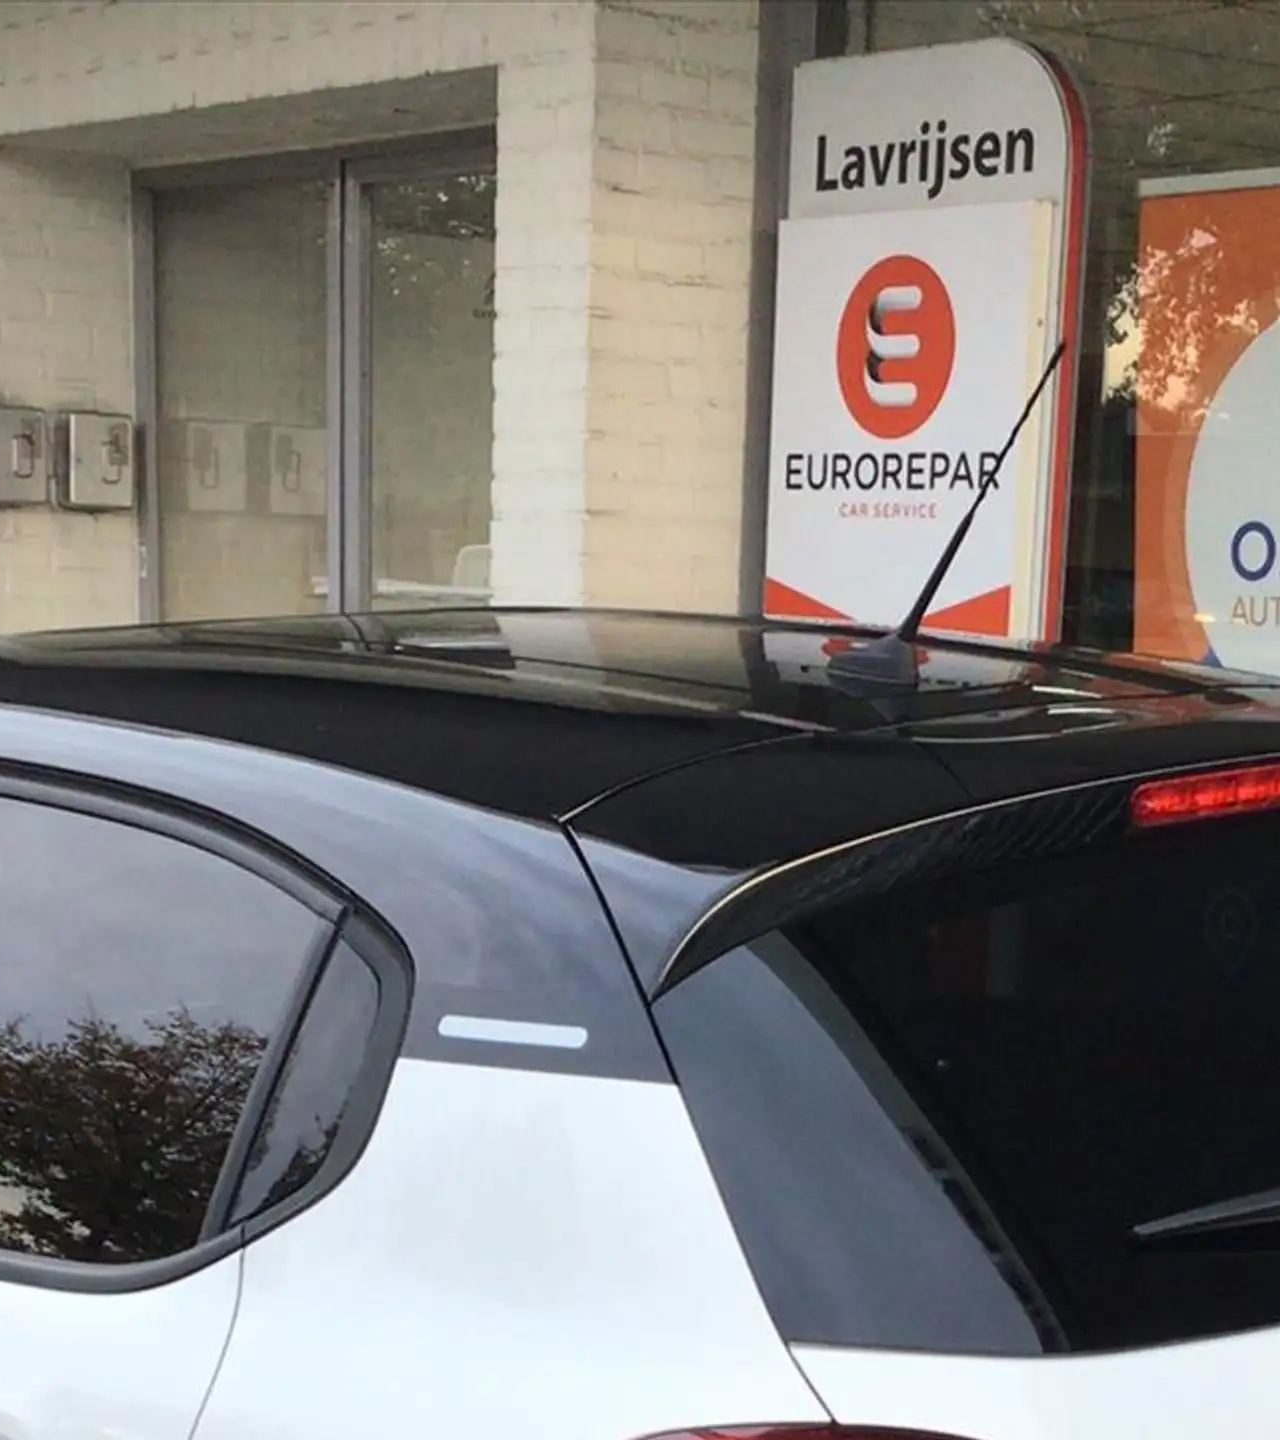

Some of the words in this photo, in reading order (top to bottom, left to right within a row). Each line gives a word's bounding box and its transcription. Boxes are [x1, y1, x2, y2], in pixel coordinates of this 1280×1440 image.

[816, 120, 1035, 200] Lavrijsen
[785, 451, 1001, 491] EUROREPAR
[839, 502, 868, 518] CAR
[873, 502, 937, 519] SERVICE
